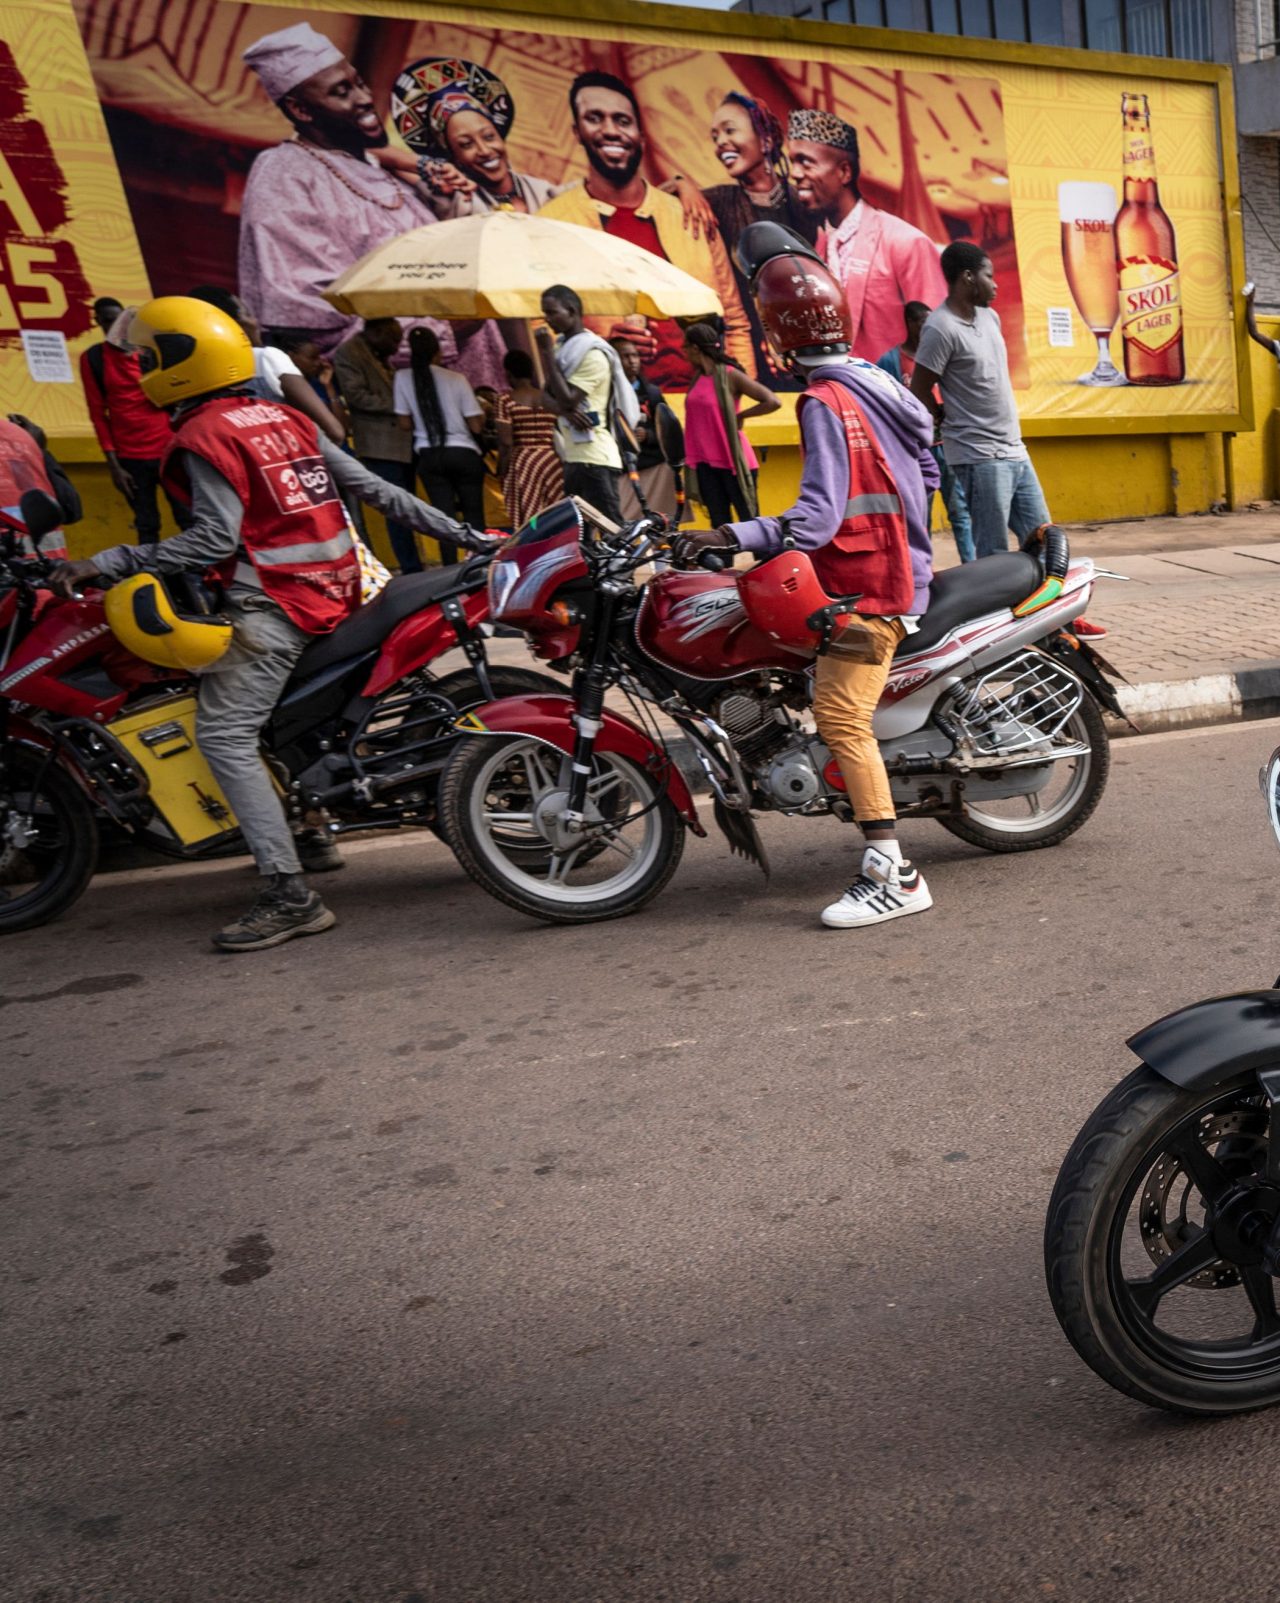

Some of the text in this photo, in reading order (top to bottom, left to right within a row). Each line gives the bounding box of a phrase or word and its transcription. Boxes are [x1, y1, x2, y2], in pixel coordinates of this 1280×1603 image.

[1074, 218, 1110, 233] SKOL
[387, 261, 468, 271] everywhere
[398, 271, 446, 280] you go
[1126, 283, 1178, 315] SKOL
[1137, 313, 1172, 333] LAGER
